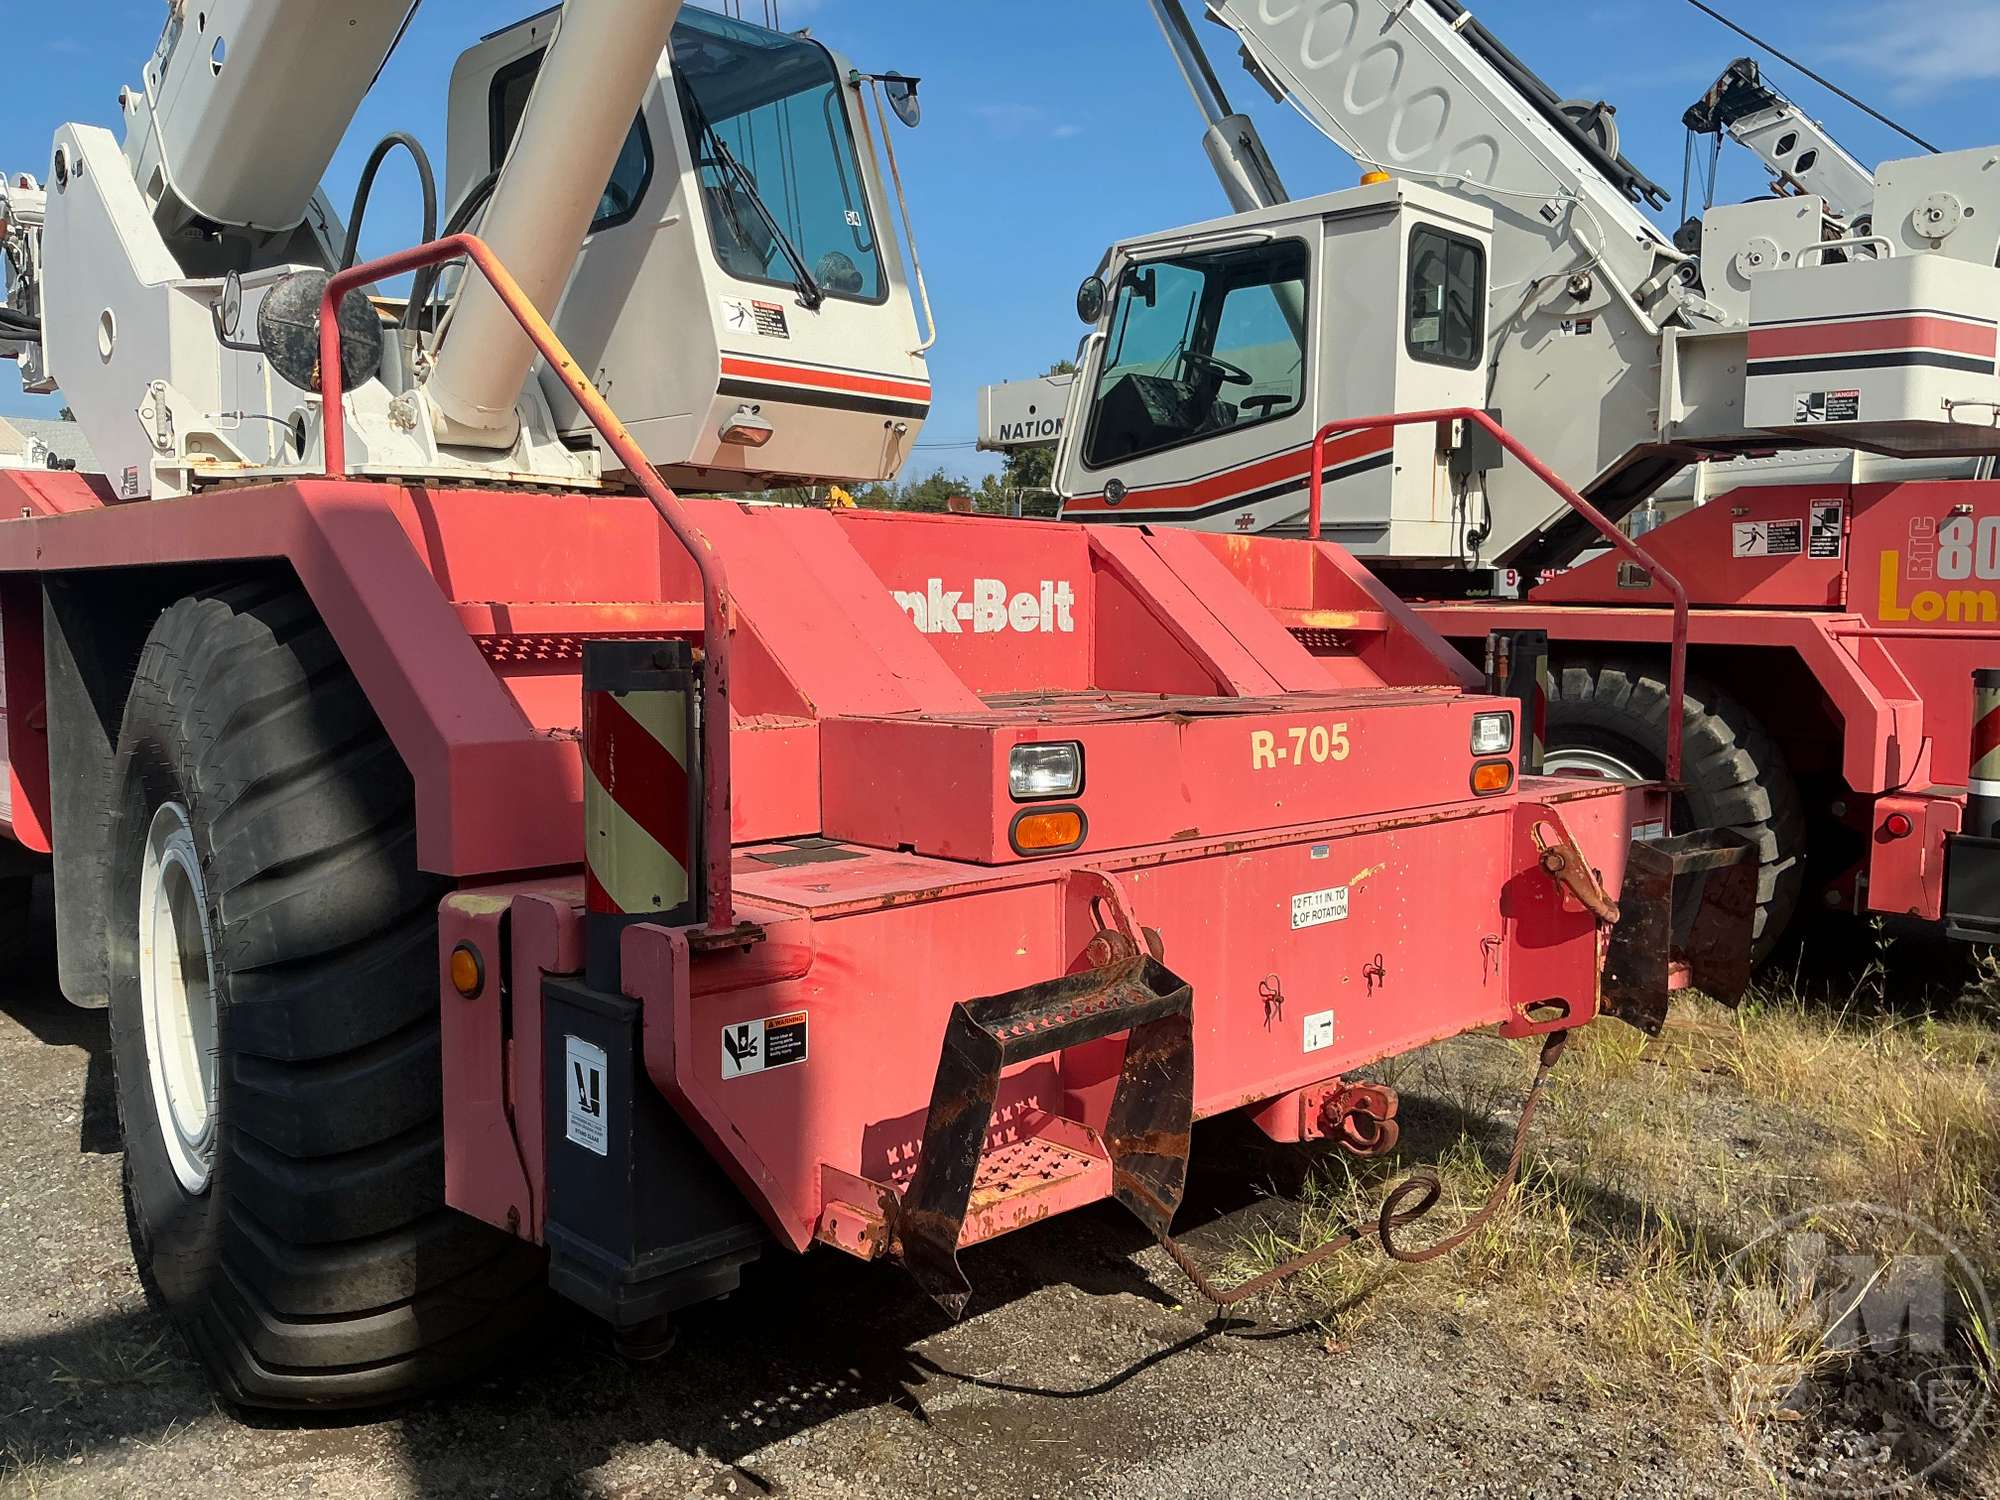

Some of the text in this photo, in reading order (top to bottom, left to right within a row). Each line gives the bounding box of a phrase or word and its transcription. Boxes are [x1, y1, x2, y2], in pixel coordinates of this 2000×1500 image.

[1906, 516, 1936, 580] RTC
[888, 577, 1074, 633] nk-Belt
[1251, 722, 1350, 770] R-705
[1293, 898, 1301, 909] 12
[1316, 894, 1322, 905] 11
[1335, 889, 1345, 901] TO
[1300, 911, 1310, 923] OF
[1312, 904, 1346, 920] ROTATION
[775, 1016, 804, 1026] WARNING
